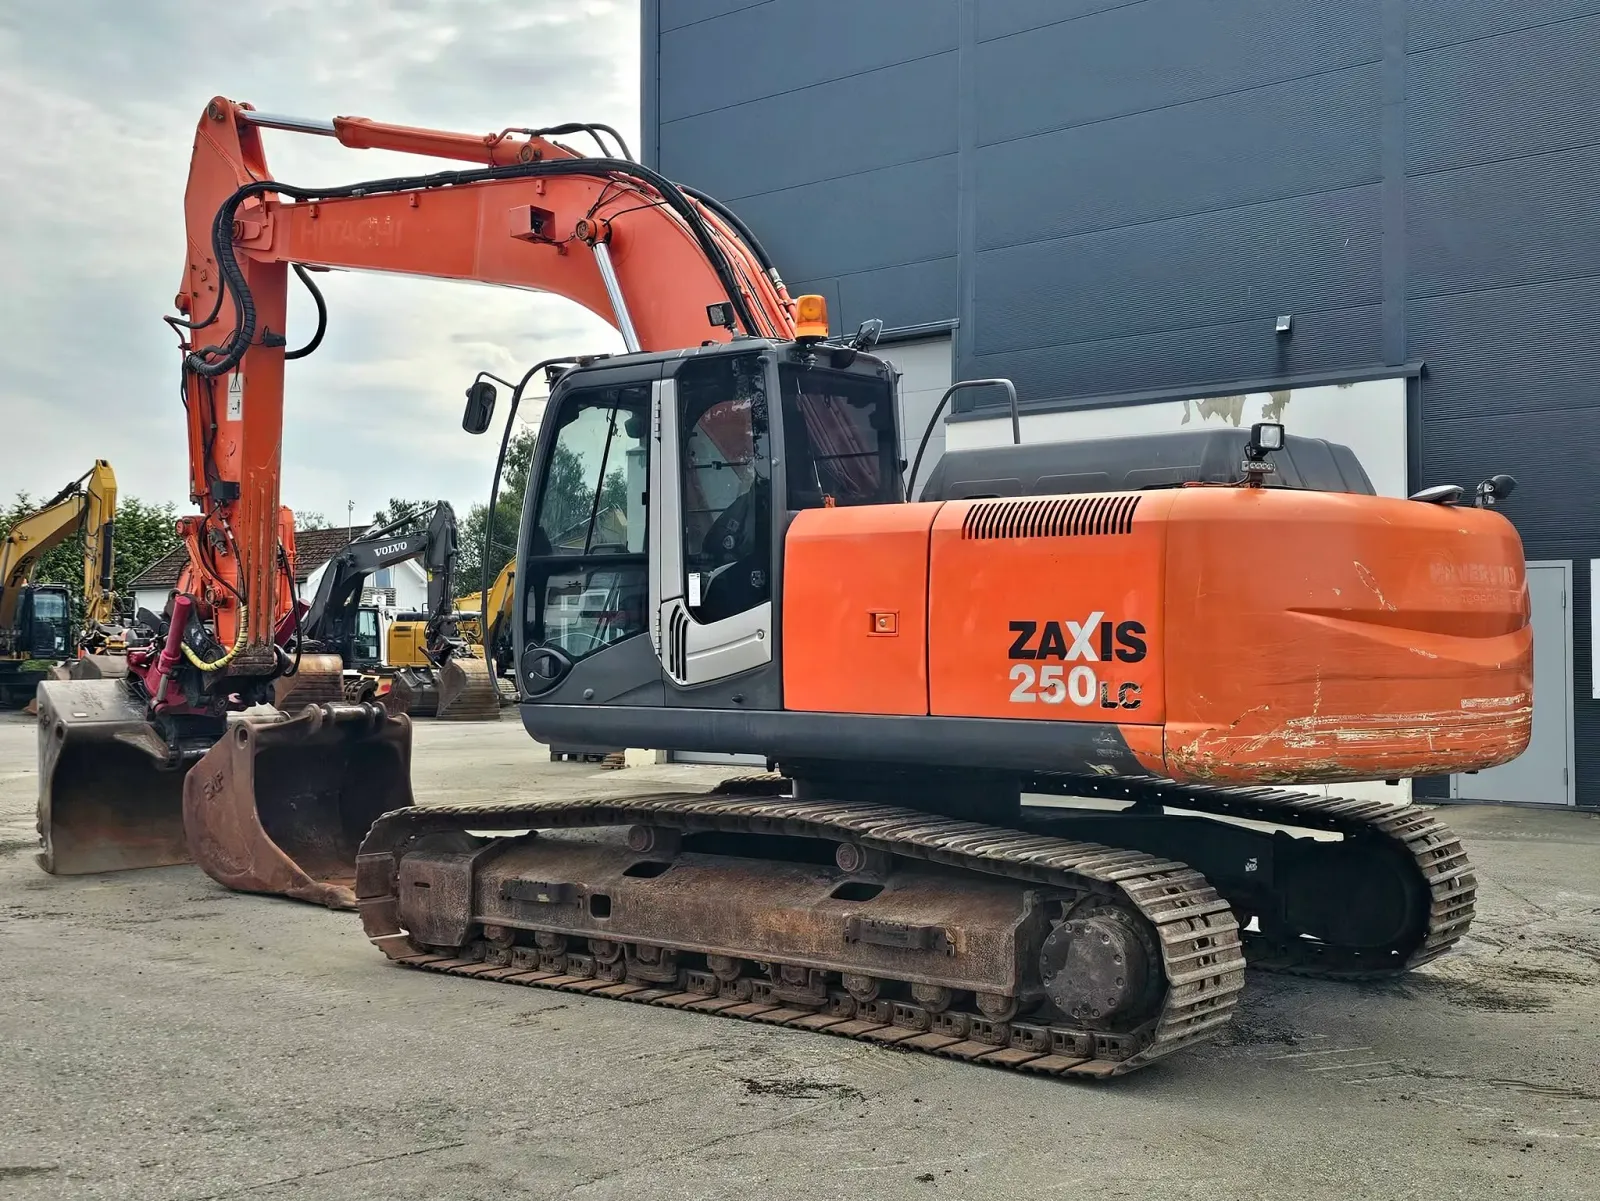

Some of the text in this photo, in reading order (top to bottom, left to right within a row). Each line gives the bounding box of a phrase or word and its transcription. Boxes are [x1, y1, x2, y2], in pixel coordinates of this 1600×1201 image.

[300, 217, 403, 247] HITACHI
[374, 541, 408, 557] VOLVO
[1008, 611, 1148, 663] ZAXIS
